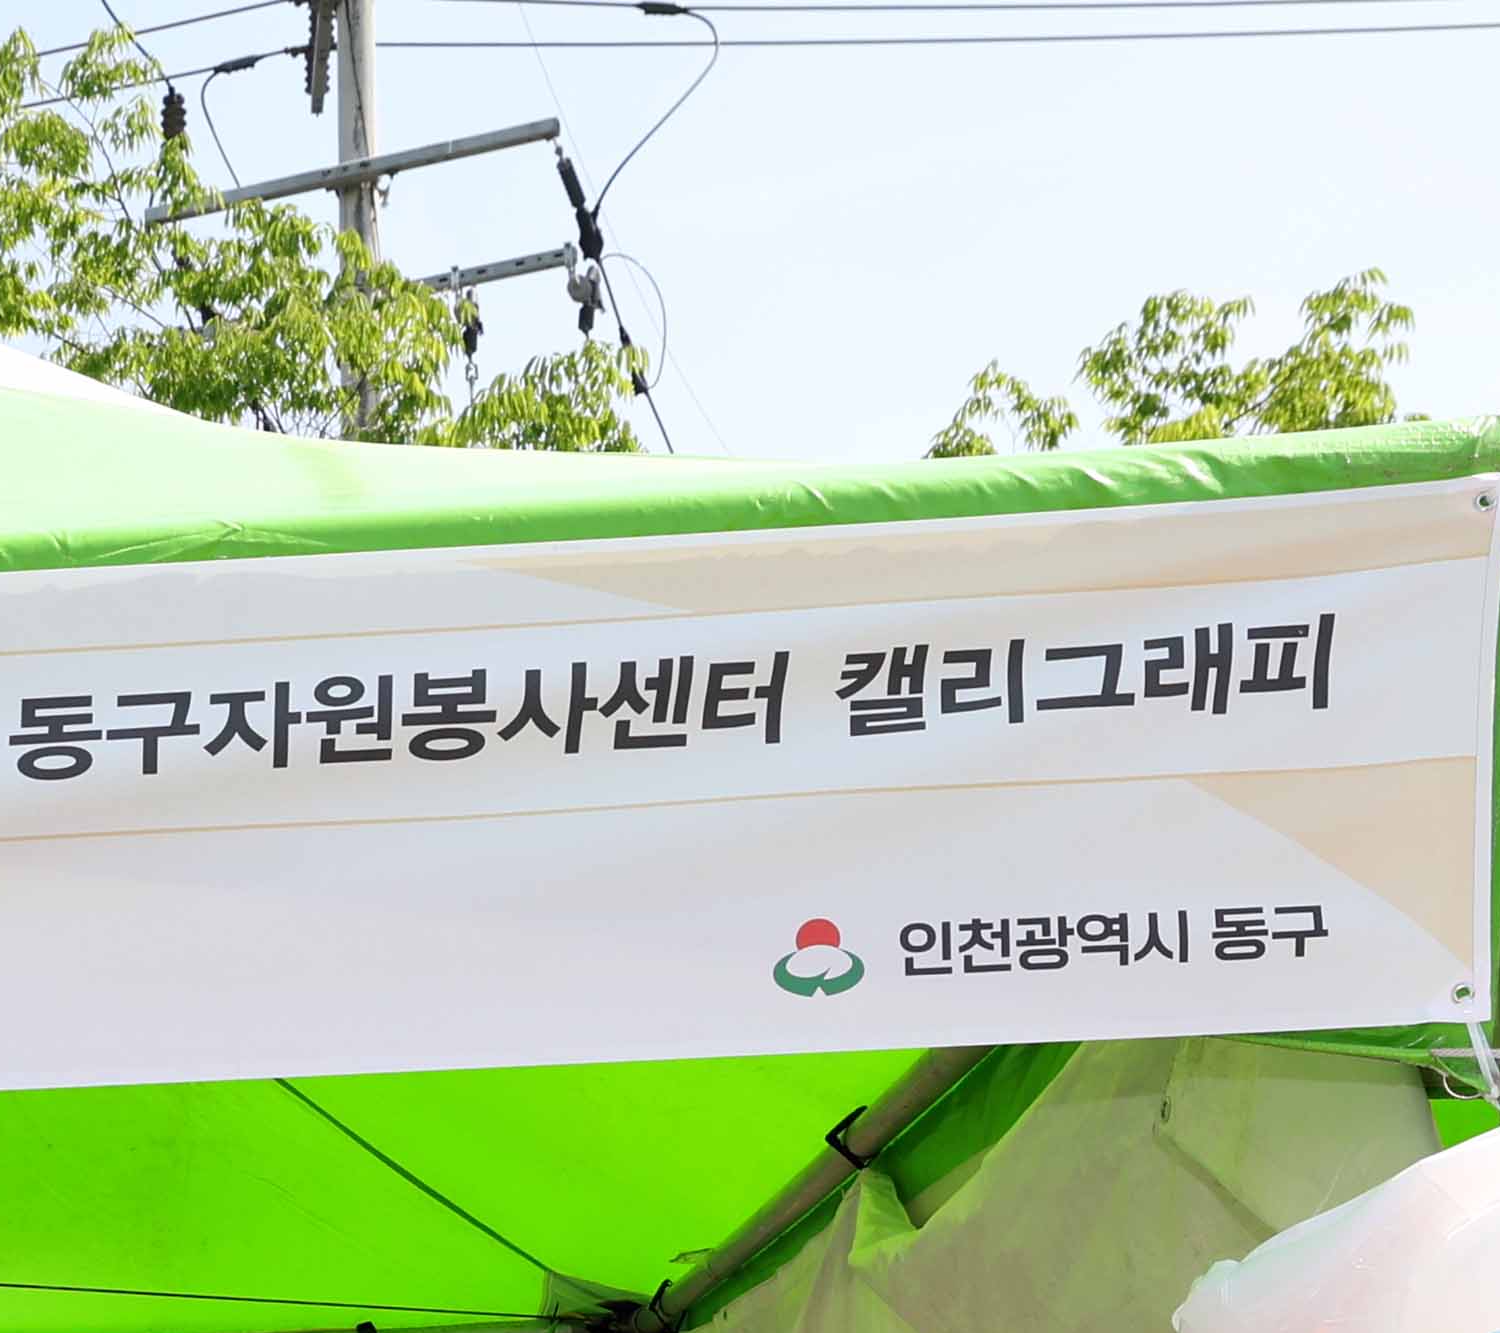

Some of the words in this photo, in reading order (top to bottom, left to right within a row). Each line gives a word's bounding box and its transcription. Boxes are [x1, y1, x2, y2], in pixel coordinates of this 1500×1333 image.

[8, 649, 790, 781] 동구자원봉사센터
[834, 612, 1336, 737] 캘리그래피
[898, 910, 1190, 977] 인천광역시
[1211, 904, 1330, 961] 동구
